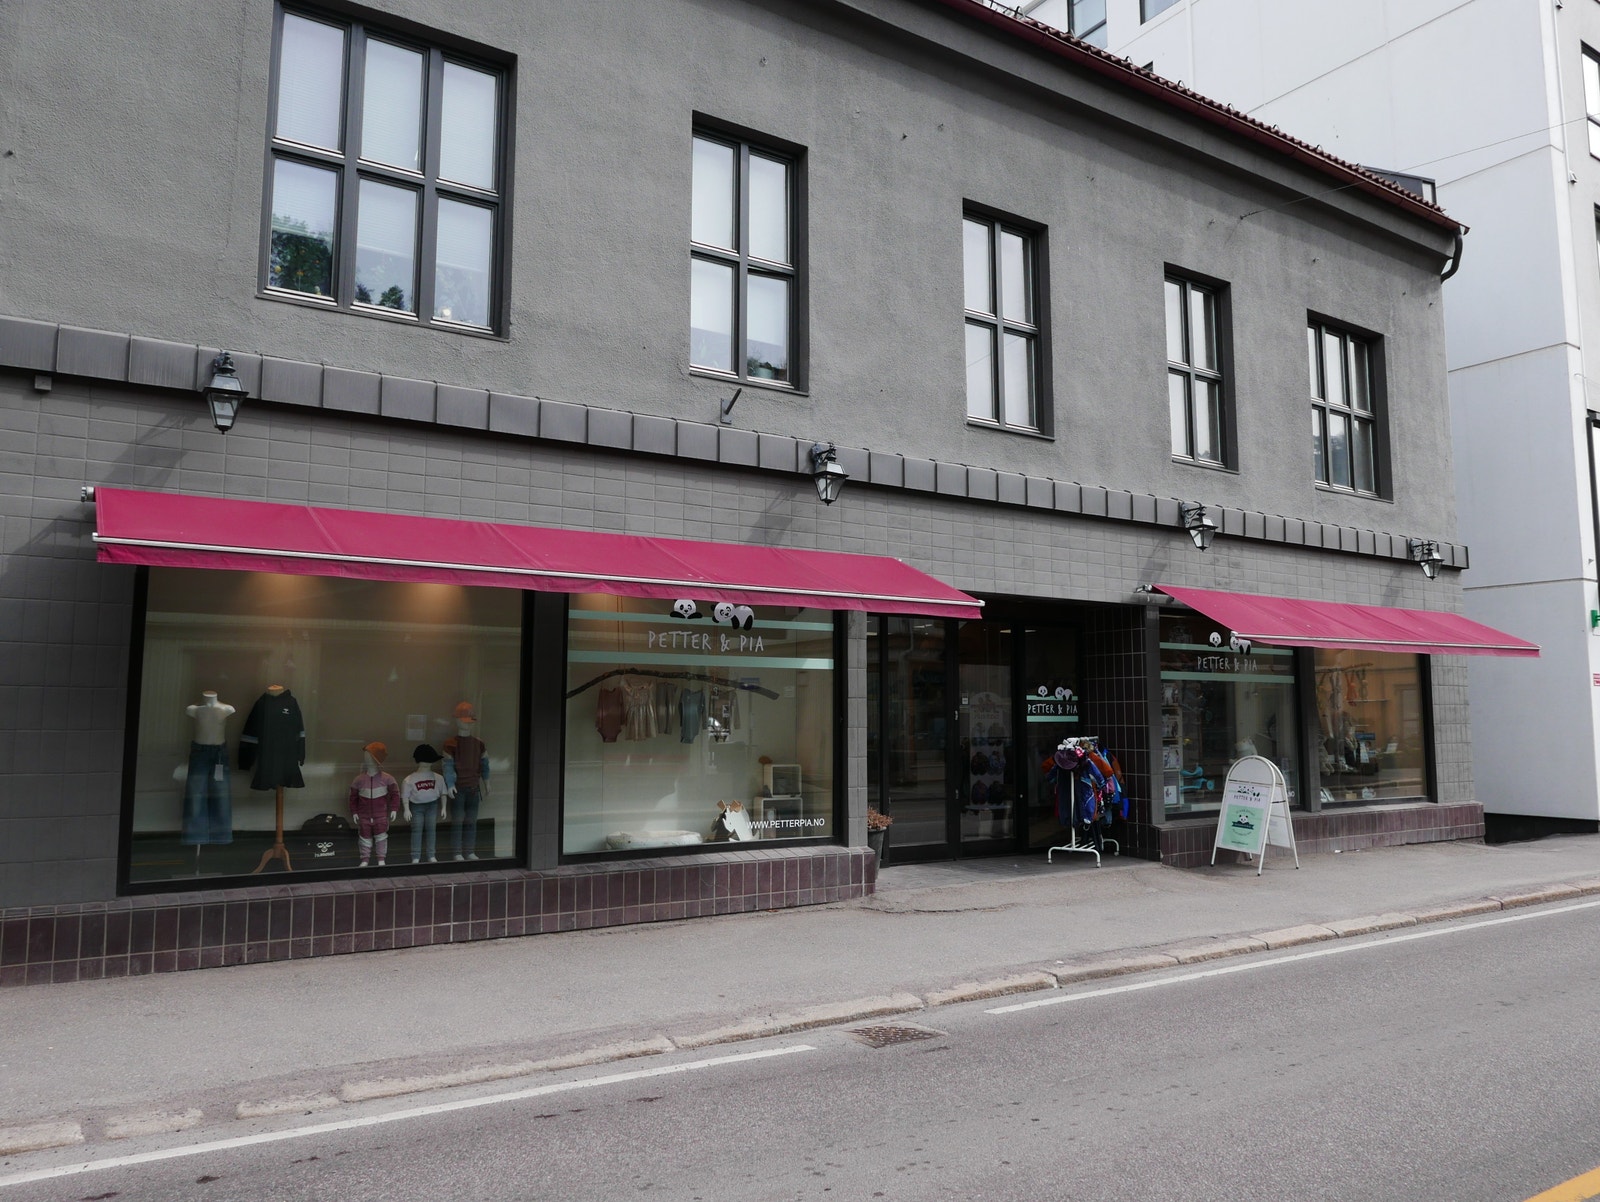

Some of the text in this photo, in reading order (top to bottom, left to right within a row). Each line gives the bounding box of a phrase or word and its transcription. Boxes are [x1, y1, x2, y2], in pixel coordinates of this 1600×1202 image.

[648, 630, 764, 652] PETTER & PIA
[1197, 656, 1258, 672] PETTER & PIA
[1027, 703, 1078, 715] PETTER & PIA
[747, 818, 825, 829] WWW.PETTERPIA.NO
